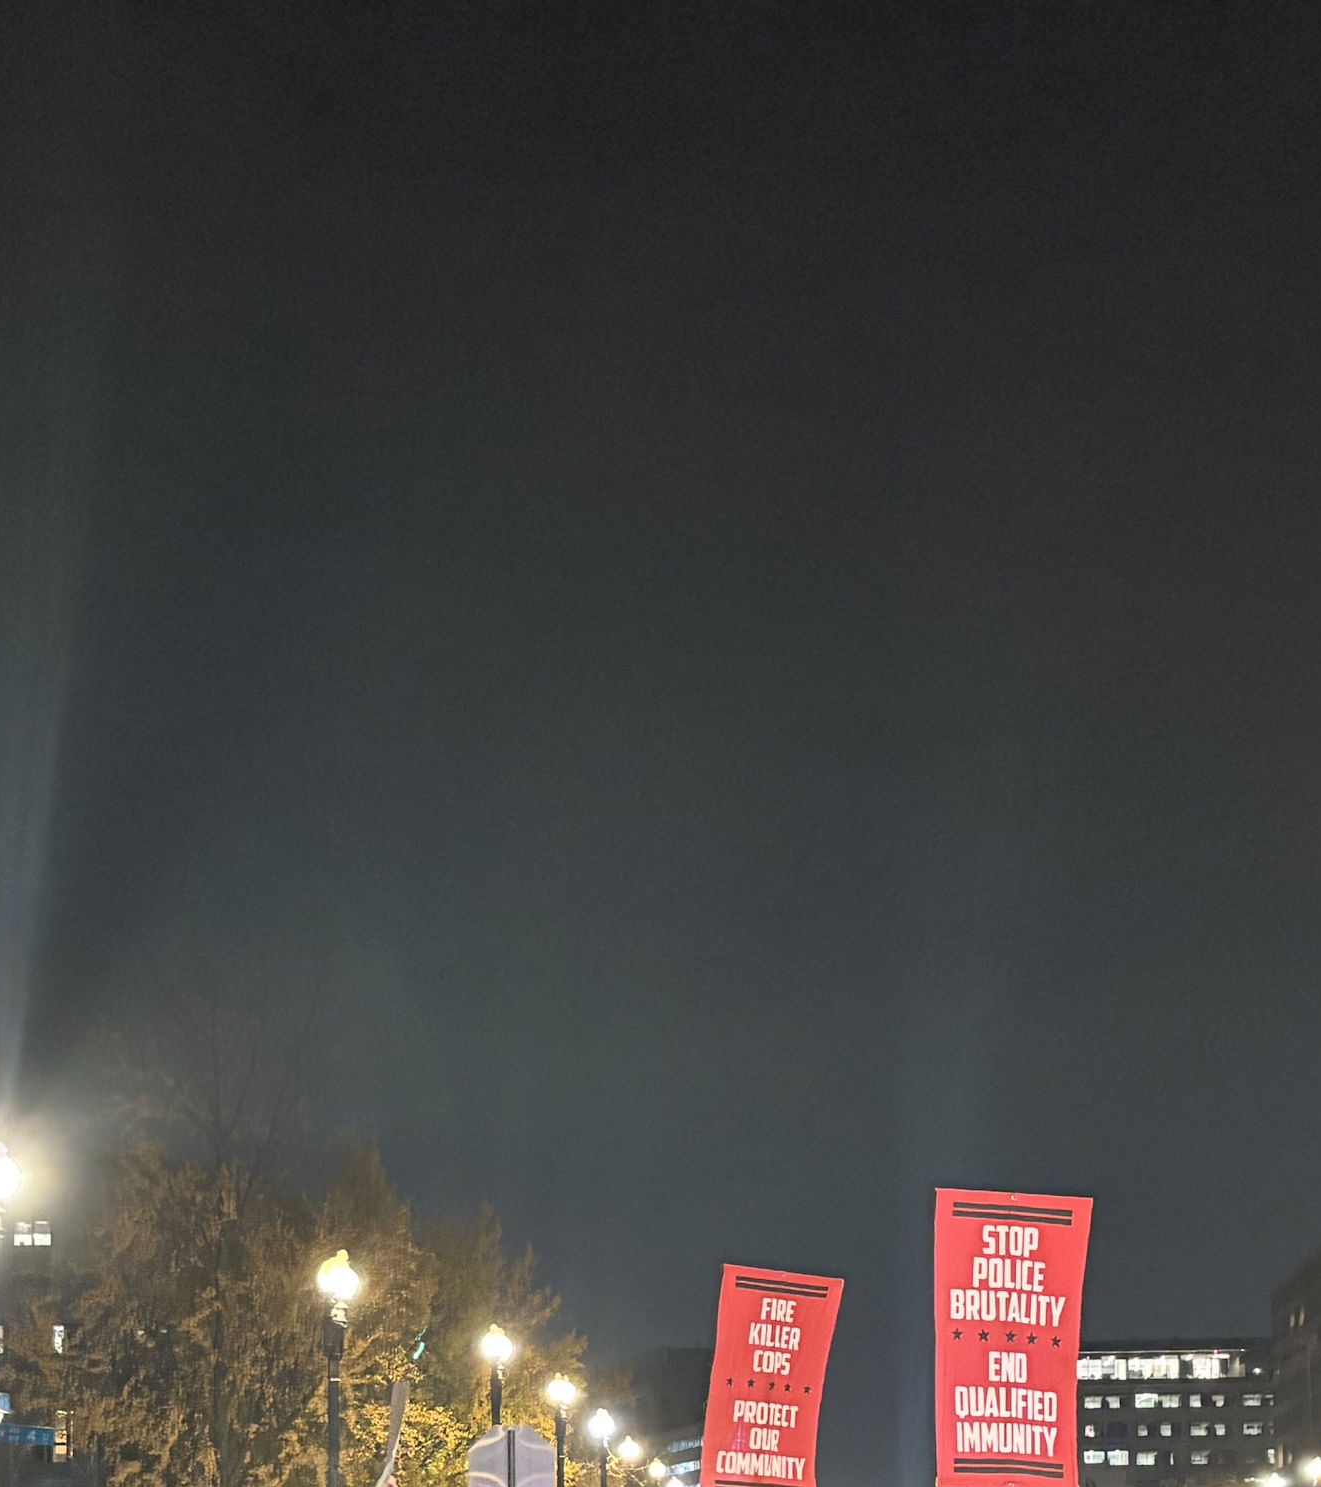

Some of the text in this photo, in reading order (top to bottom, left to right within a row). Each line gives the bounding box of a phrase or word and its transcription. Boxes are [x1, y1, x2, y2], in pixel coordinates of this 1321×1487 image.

[982, 1224, 1039, 1258] STOP
[972, 1256, 1046, 1293] POLICE
[760, 1297, 797, 1323] FIRE
[949, 1288, 1067, 1328] BRUTALITY
[748, 1322, 801, 1351] KILLER
[752, 1349, 792, 1376] COPS
[988, 1351, 1028, 1384] END
[733, 1400, 799, 1429] PROTECT
[954, 1385, 1058, 1423] QUALIFIED
[749, 1427, 780, 1452] OUR
[956, 1421, 1058, 1458] IMMUNITY
[715, 1450, 806, 1481] COMMUNITY
